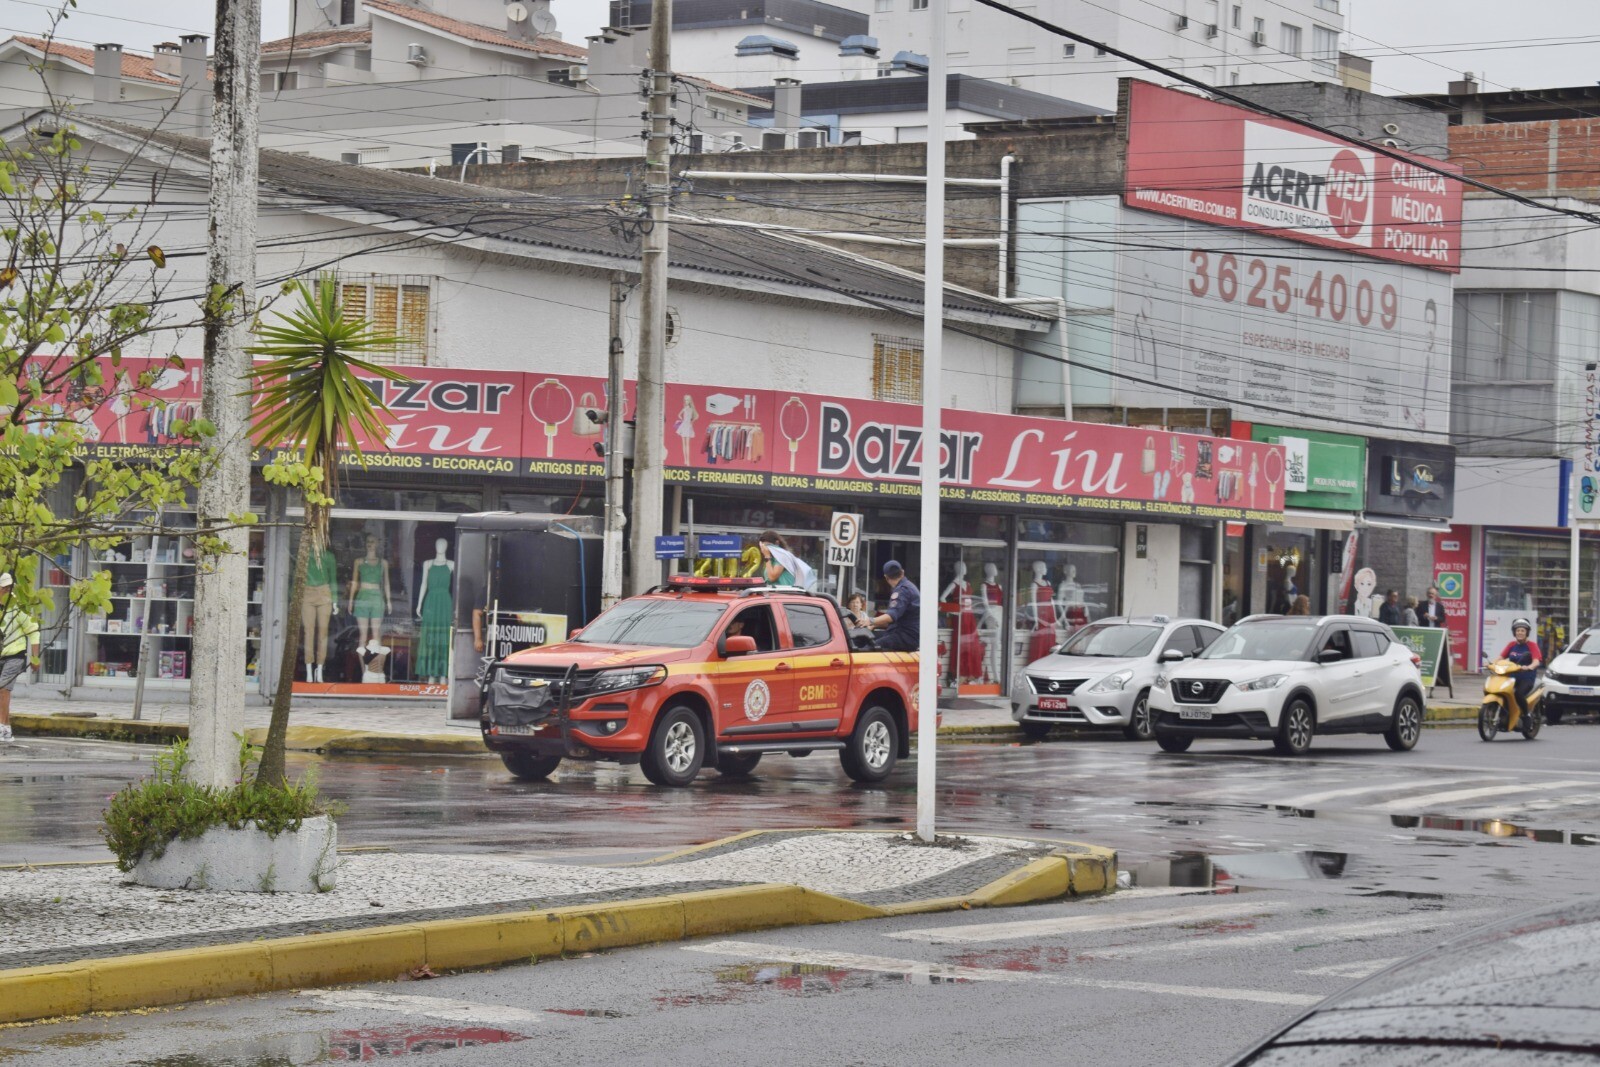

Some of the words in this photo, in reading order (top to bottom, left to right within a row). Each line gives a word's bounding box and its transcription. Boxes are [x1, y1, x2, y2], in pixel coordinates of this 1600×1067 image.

[1248, 162, 1325, 211] ACERT
[1326, 167, 1367, 202] MED
[1135, 187, 1237, 219] WWW.ACERTMED.COM.BR
[1247, 203, 1293, 224] CONSULTAS
[1296, 213, 1330, 232] MÉDICAS
[1391, 193, 1444, 228] MÉDICA
[1384, 227, 1448, 262] POPULAR
[817, 402, 983, 485] Bazar
[339, 453, 422, 468] ACESSÓRIOS
[433, 457, 513, 473] DECORAÇÃO
[529, 462, 572, 475] ARTIGOS
[574, 464, 588, 475] DE
[697, 471, 764, 486] FERRAMENTAS
[771, 477, 808, 489] ROUPAS
[815, 481, 873, 493] MAQUIAGENS
[879, 484, 922, 496] BIJUTERIA
[939, 488, 966, 499] OLSAS
[971, 490, 1020, 503] ACESSÓRIOS
[1026, 494, 1072, 507] DECORAÇÃO
[1077, 497, 1107, 509] ARTIGOS
[1109, 500, 1120, 509] DE
[1121, 501, 1142, 511] PRAIA
[1146, 502, 1191, 515] ELETRÔNICOS
[1196, 506, 1241, 519] FERRAMENTAS
[1245, 510, 1284, 521] BRINQUEDOS
[838, 521, 850, 541] E
[831, 546, 854, 563] TAXI
[1435, 562, 1451, 571] AQUI
[1453, 563, 1467, 571] TEM
[400, 684, 420, 692] BAZAR
